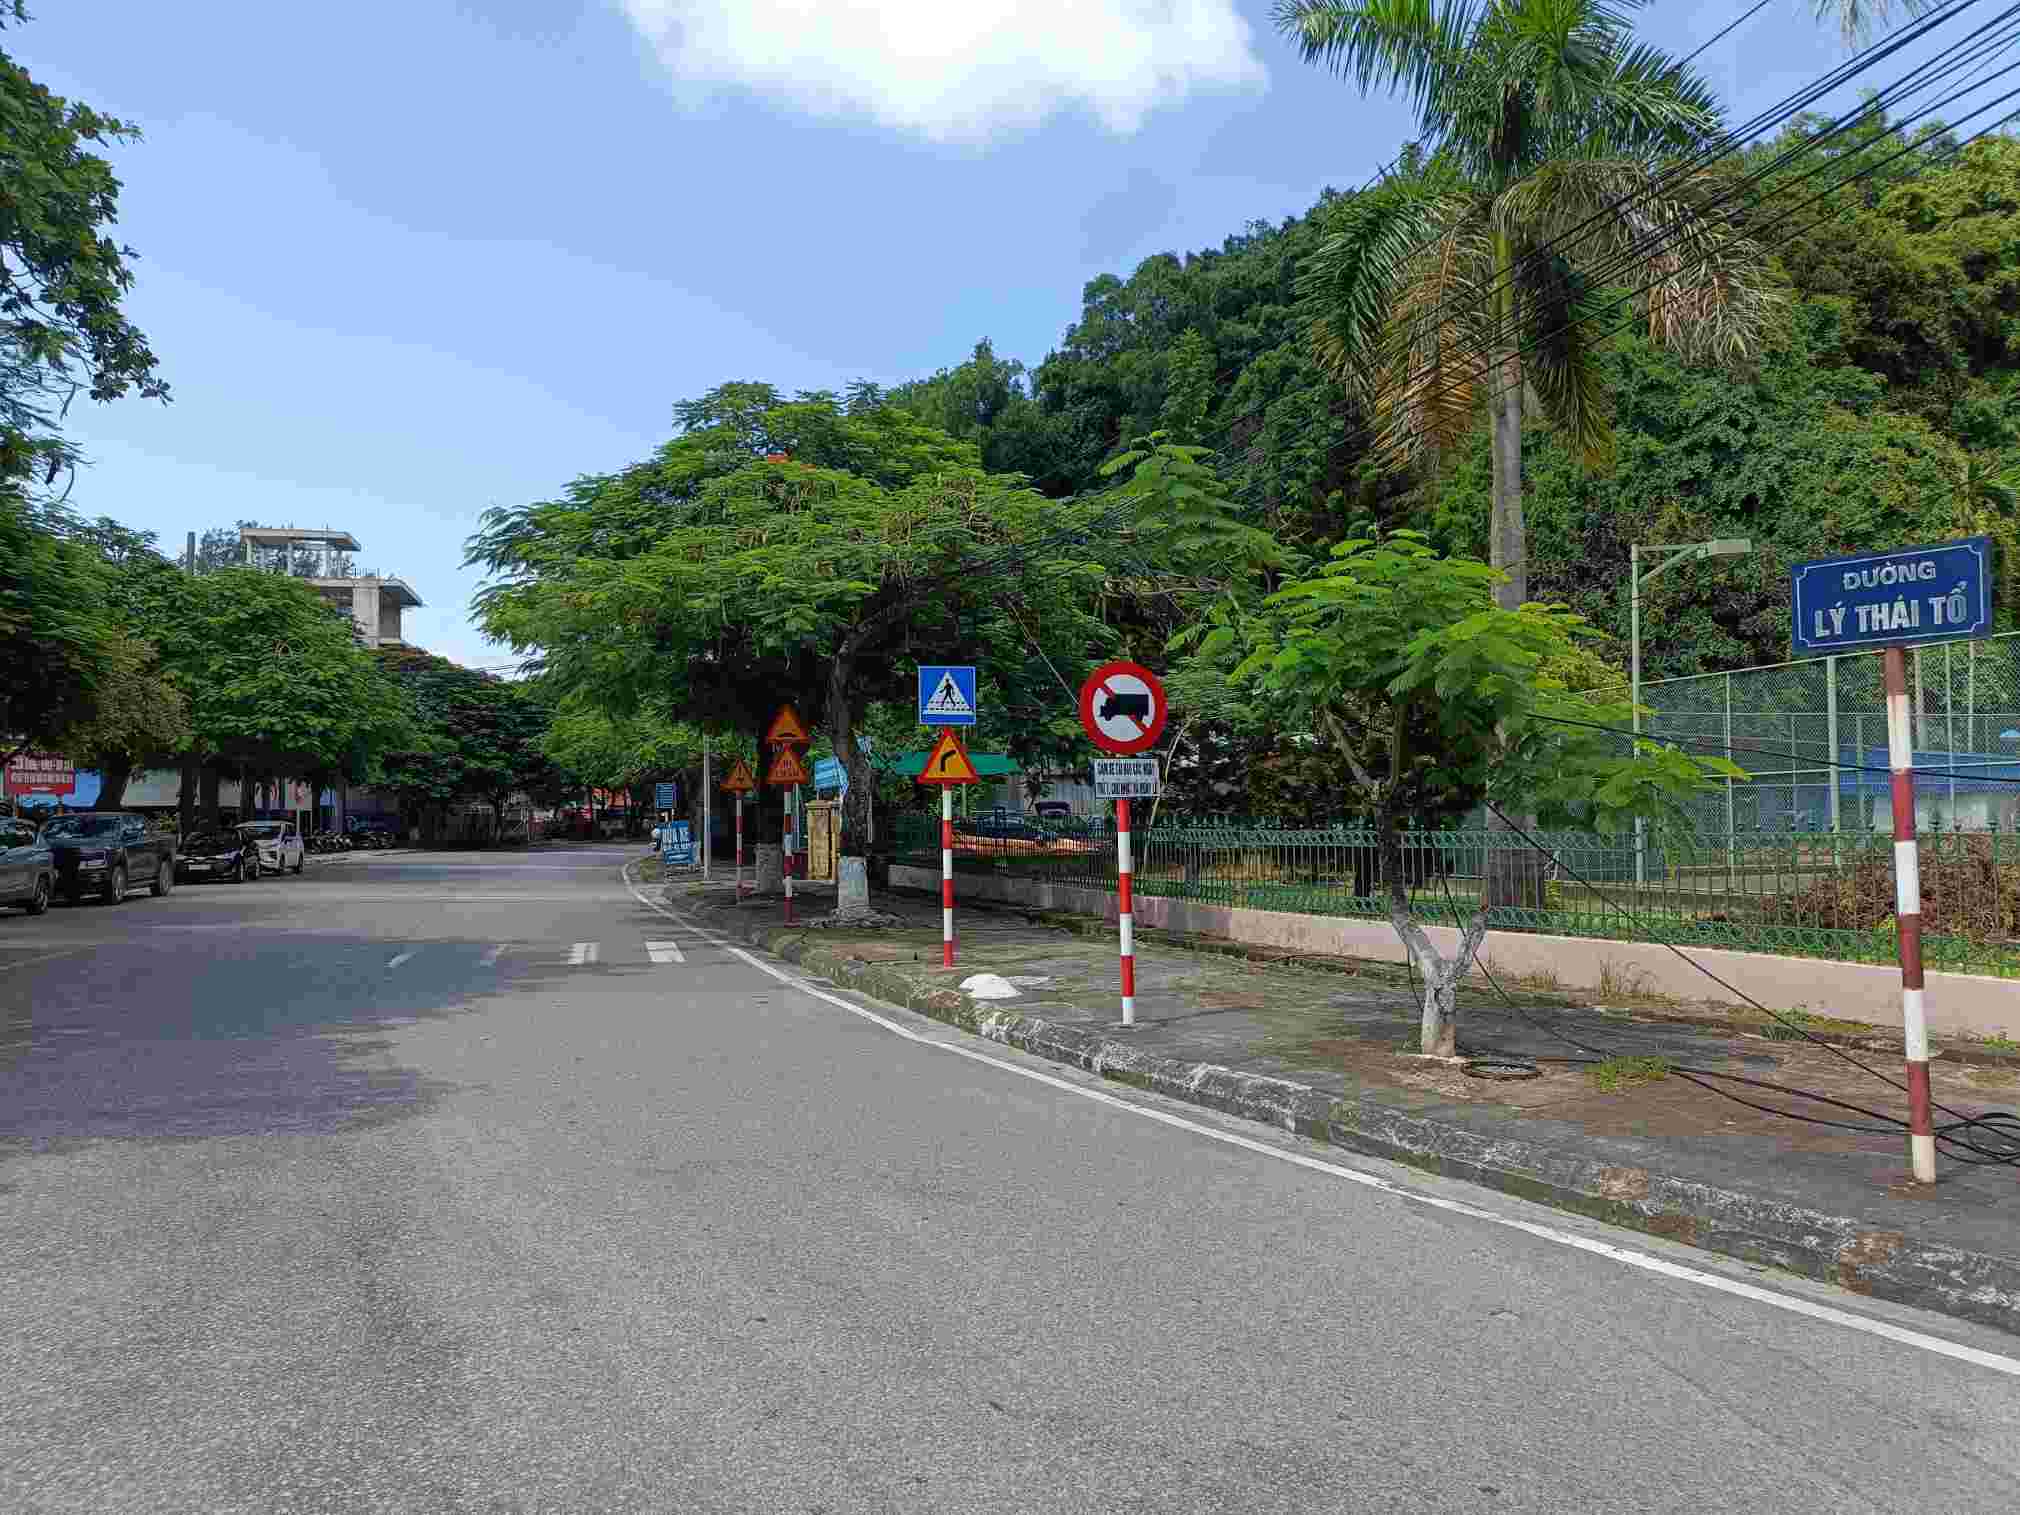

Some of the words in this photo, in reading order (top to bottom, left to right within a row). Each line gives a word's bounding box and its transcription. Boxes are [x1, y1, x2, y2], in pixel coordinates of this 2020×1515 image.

[1842, 560, 1937, 590] ĐƯỜNG
[1814, 600, 1848, 638] LÝ
[1855, 593, 1920, 633] THÁI
[1928, 580, 1969, 625] TỔ
